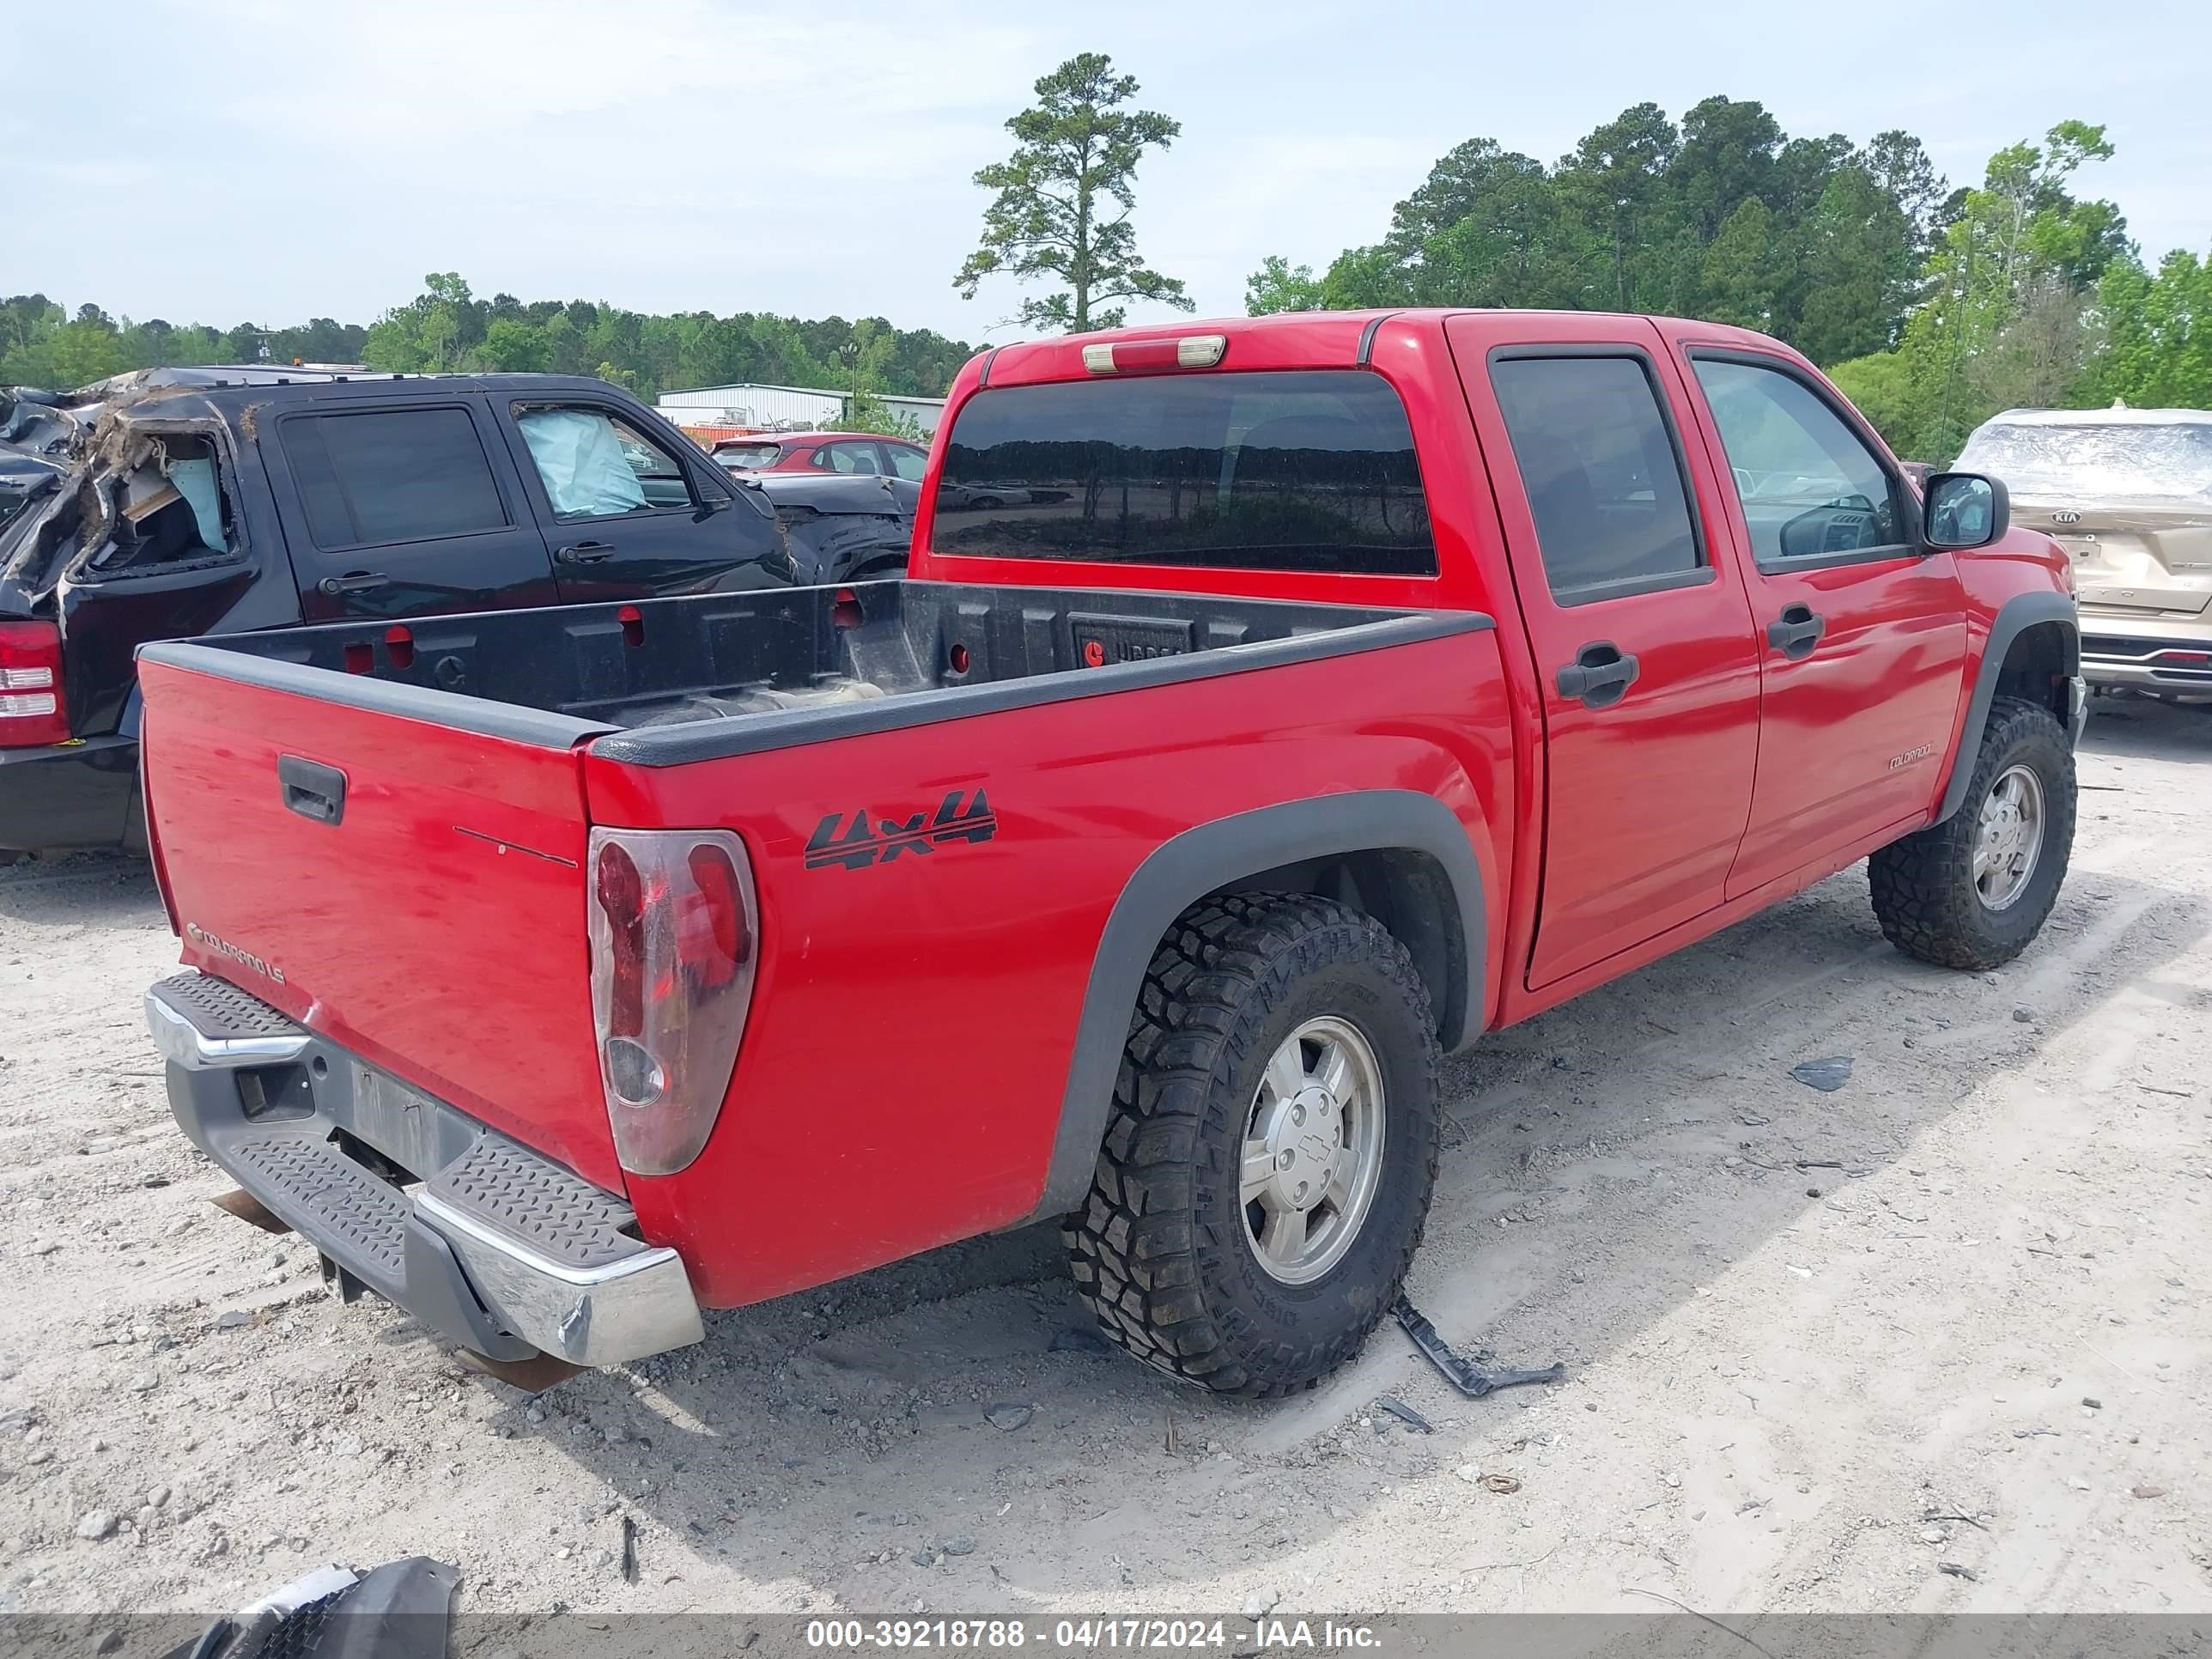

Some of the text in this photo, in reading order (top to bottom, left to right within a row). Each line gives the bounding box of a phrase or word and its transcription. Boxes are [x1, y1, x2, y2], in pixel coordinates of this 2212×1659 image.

[2055, 513, 2078, 523] KIA
[1889, 743, 1931, 770] COLORADO
[203, 931, 286, 986] COLORADO LS
